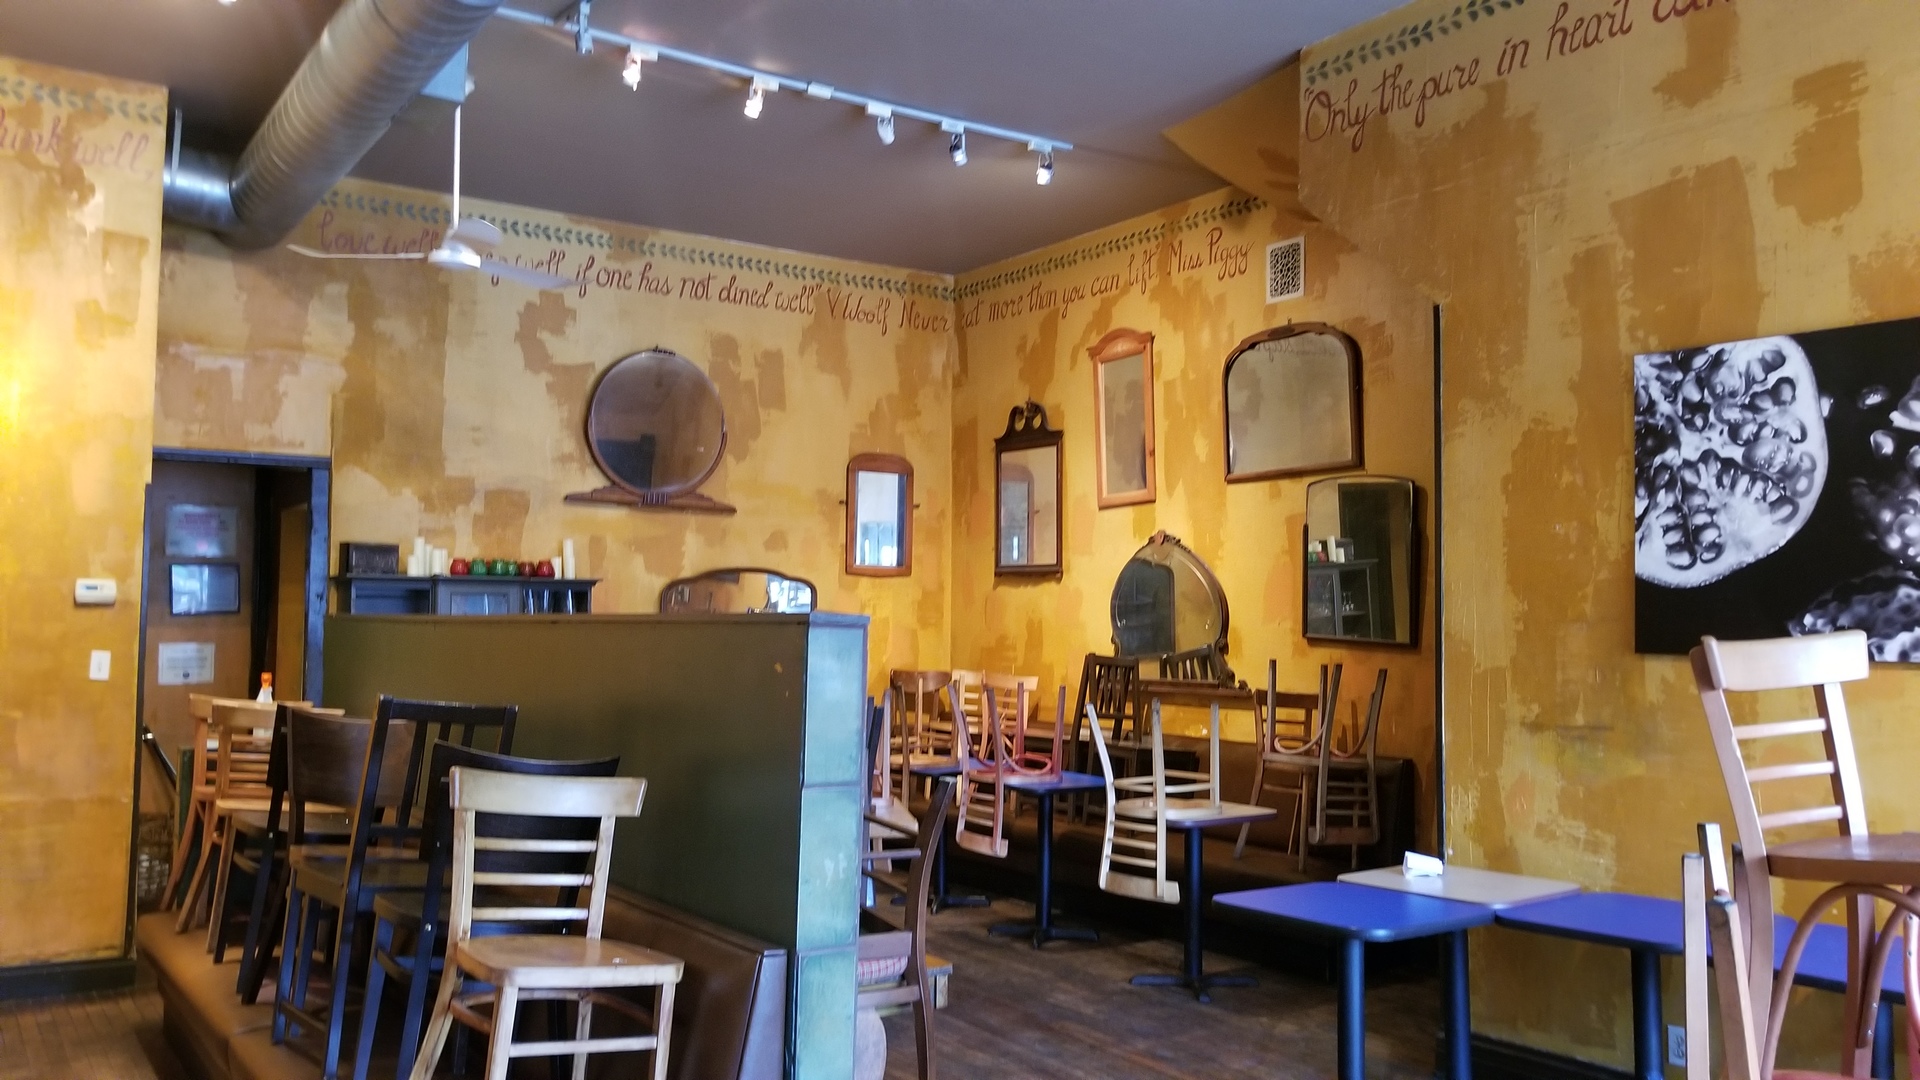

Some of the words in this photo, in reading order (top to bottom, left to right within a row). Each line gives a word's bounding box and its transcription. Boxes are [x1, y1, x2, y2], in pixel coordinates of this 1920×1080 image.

[1372, 63, 1415, 115] the
[1405, 58, 1480, 128] pure
[1497, 37, 1530, 77] in
[1546, 2, 1633, 61] heart
[575, 255, 596, 298] if
[596, 266, 633, 290] one
[638, 261, 673, 296] has
[679, 272, 717, 300] not
[718, 274, 773, 309] dined
[842, 293, 890, 337] Woolf
[988, 294, 1023, 323] more
[1026, 280, 1058, 313] than
[1061, 283, 1086, 320] you
[1090, 273, 1120, 297] can
[1167, 239, 1205, 276] Miss
[1205, 226, 1256, 281] Piggy
